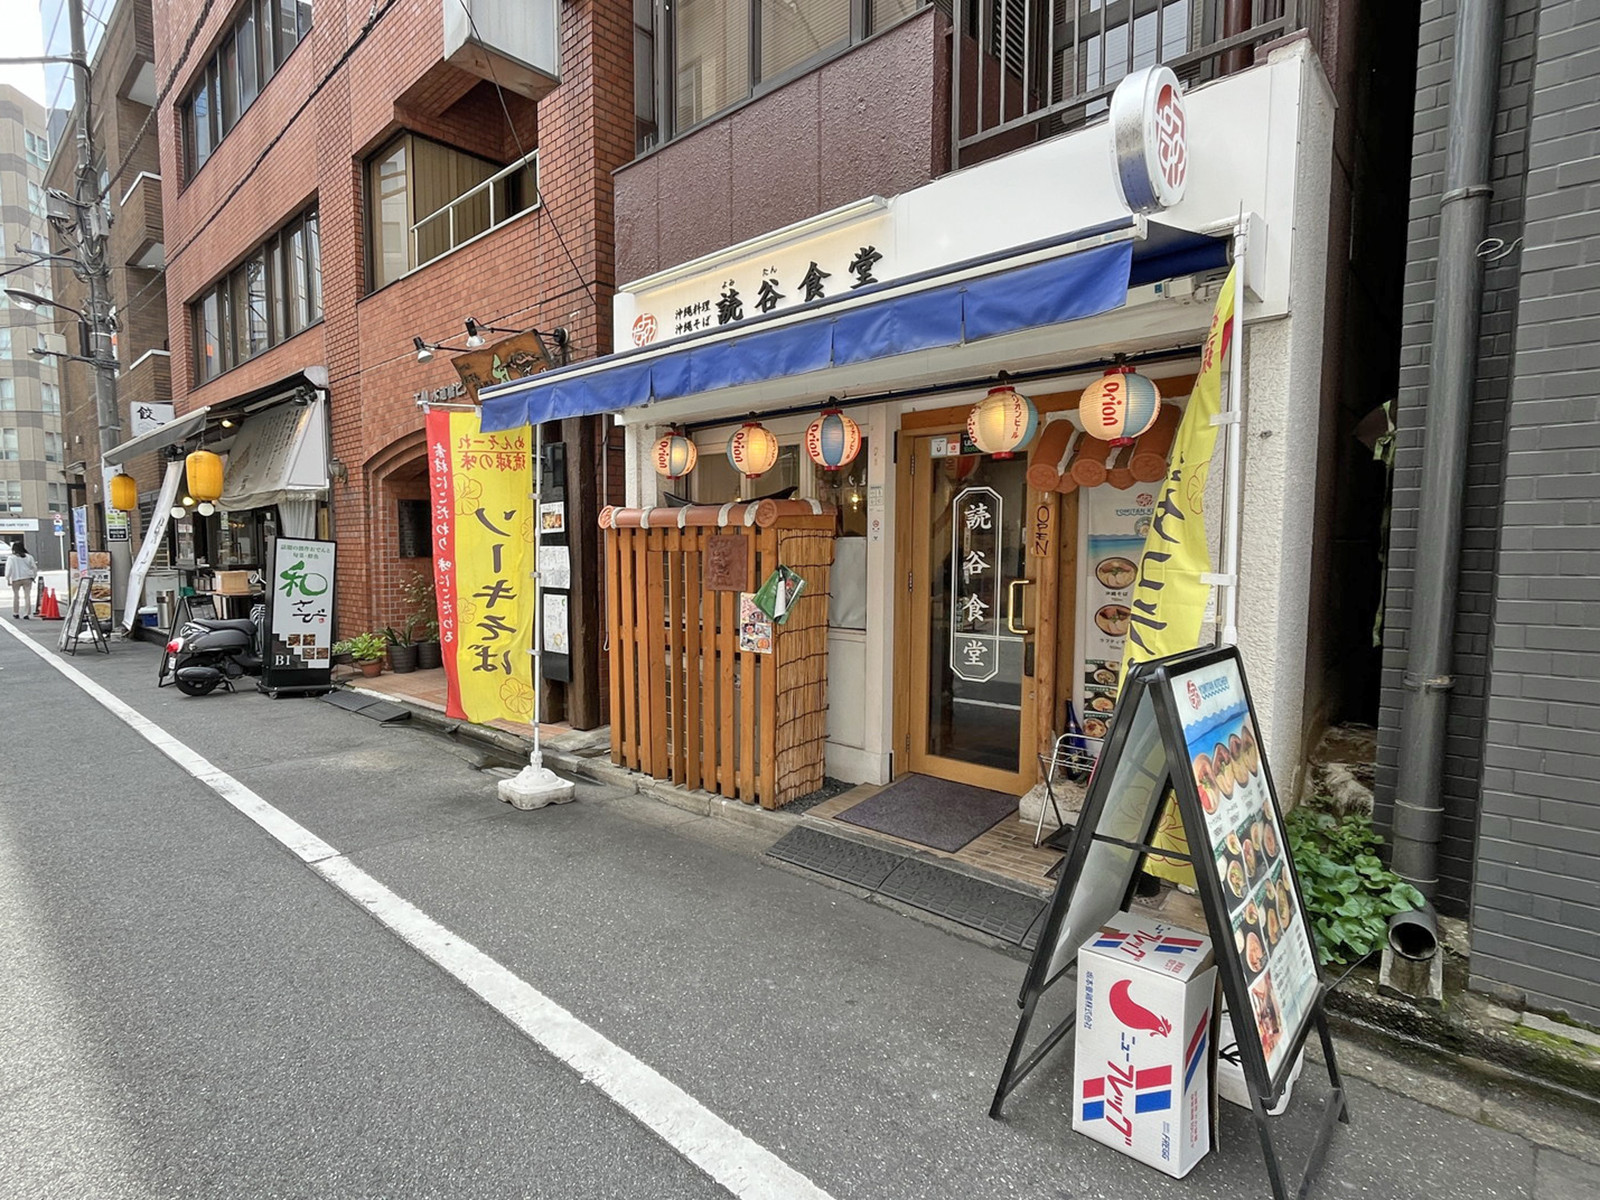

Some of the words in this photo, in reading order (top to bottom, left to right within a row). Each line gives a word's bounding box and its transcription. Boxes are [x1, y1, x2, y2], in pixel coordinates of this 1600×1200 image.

[714, 245, 884, 325] 読谷食堂
[675, 300, 711, 320] 沖縄料理
[675, 315, 711, 335] 沖縄そば
[1101, 381, 1122, 426] Orion
[658, 440, 669, 469] Orion
[734, 431, 745, 463] Orion
[807, 423, 821, 457] Orion
[1035, 505, 1050, 556] OPEN
[963, 502, 992, 667] 読谷食堂
[1106, 1061, 1134, 1146] フレッグ
